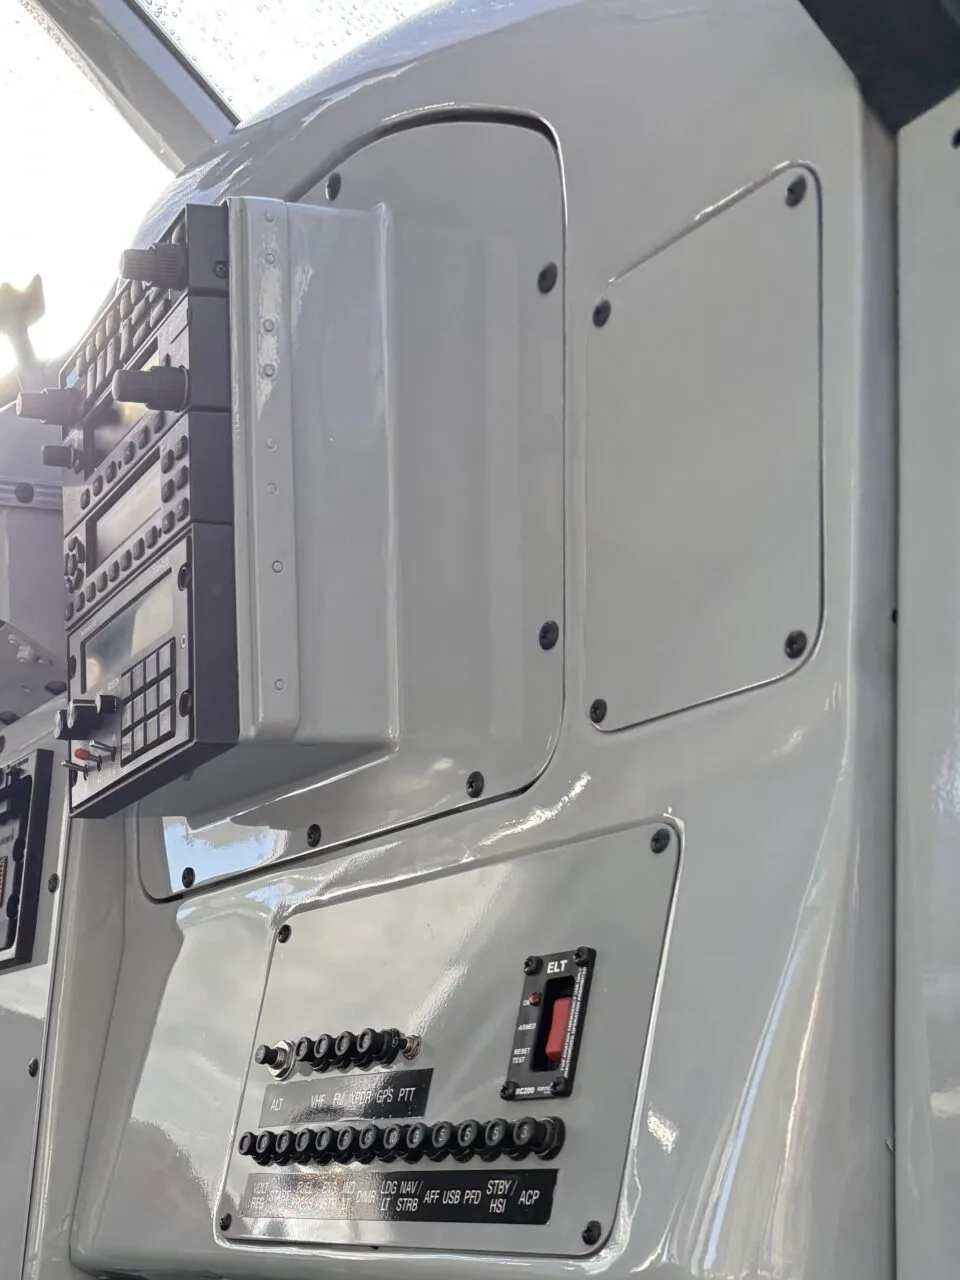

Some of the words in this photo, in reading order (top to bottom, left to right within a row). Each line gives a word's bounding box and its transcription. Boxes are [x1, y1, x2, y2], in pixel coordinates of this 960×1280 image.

[547, 960, 568, 973] ELT
[310, 1094, 326, 1108] VHF
[376, 1087, 393, 1103] GPS
[397, 1088, 416, 1101] PTT
[380, 1181, 396, 1194] LDG
[423, 1190, 439, 1203] AFF
[442, 1190, 461, 1204] USB
[463, 1190, 481, 1204] PFD
[518, 1190, 540, 1205] ACP
[380, 1198, 391, 1211] LT
[396, 1198, 418, 1211] STRB
[489, 1198, 506, 1213] HSI
